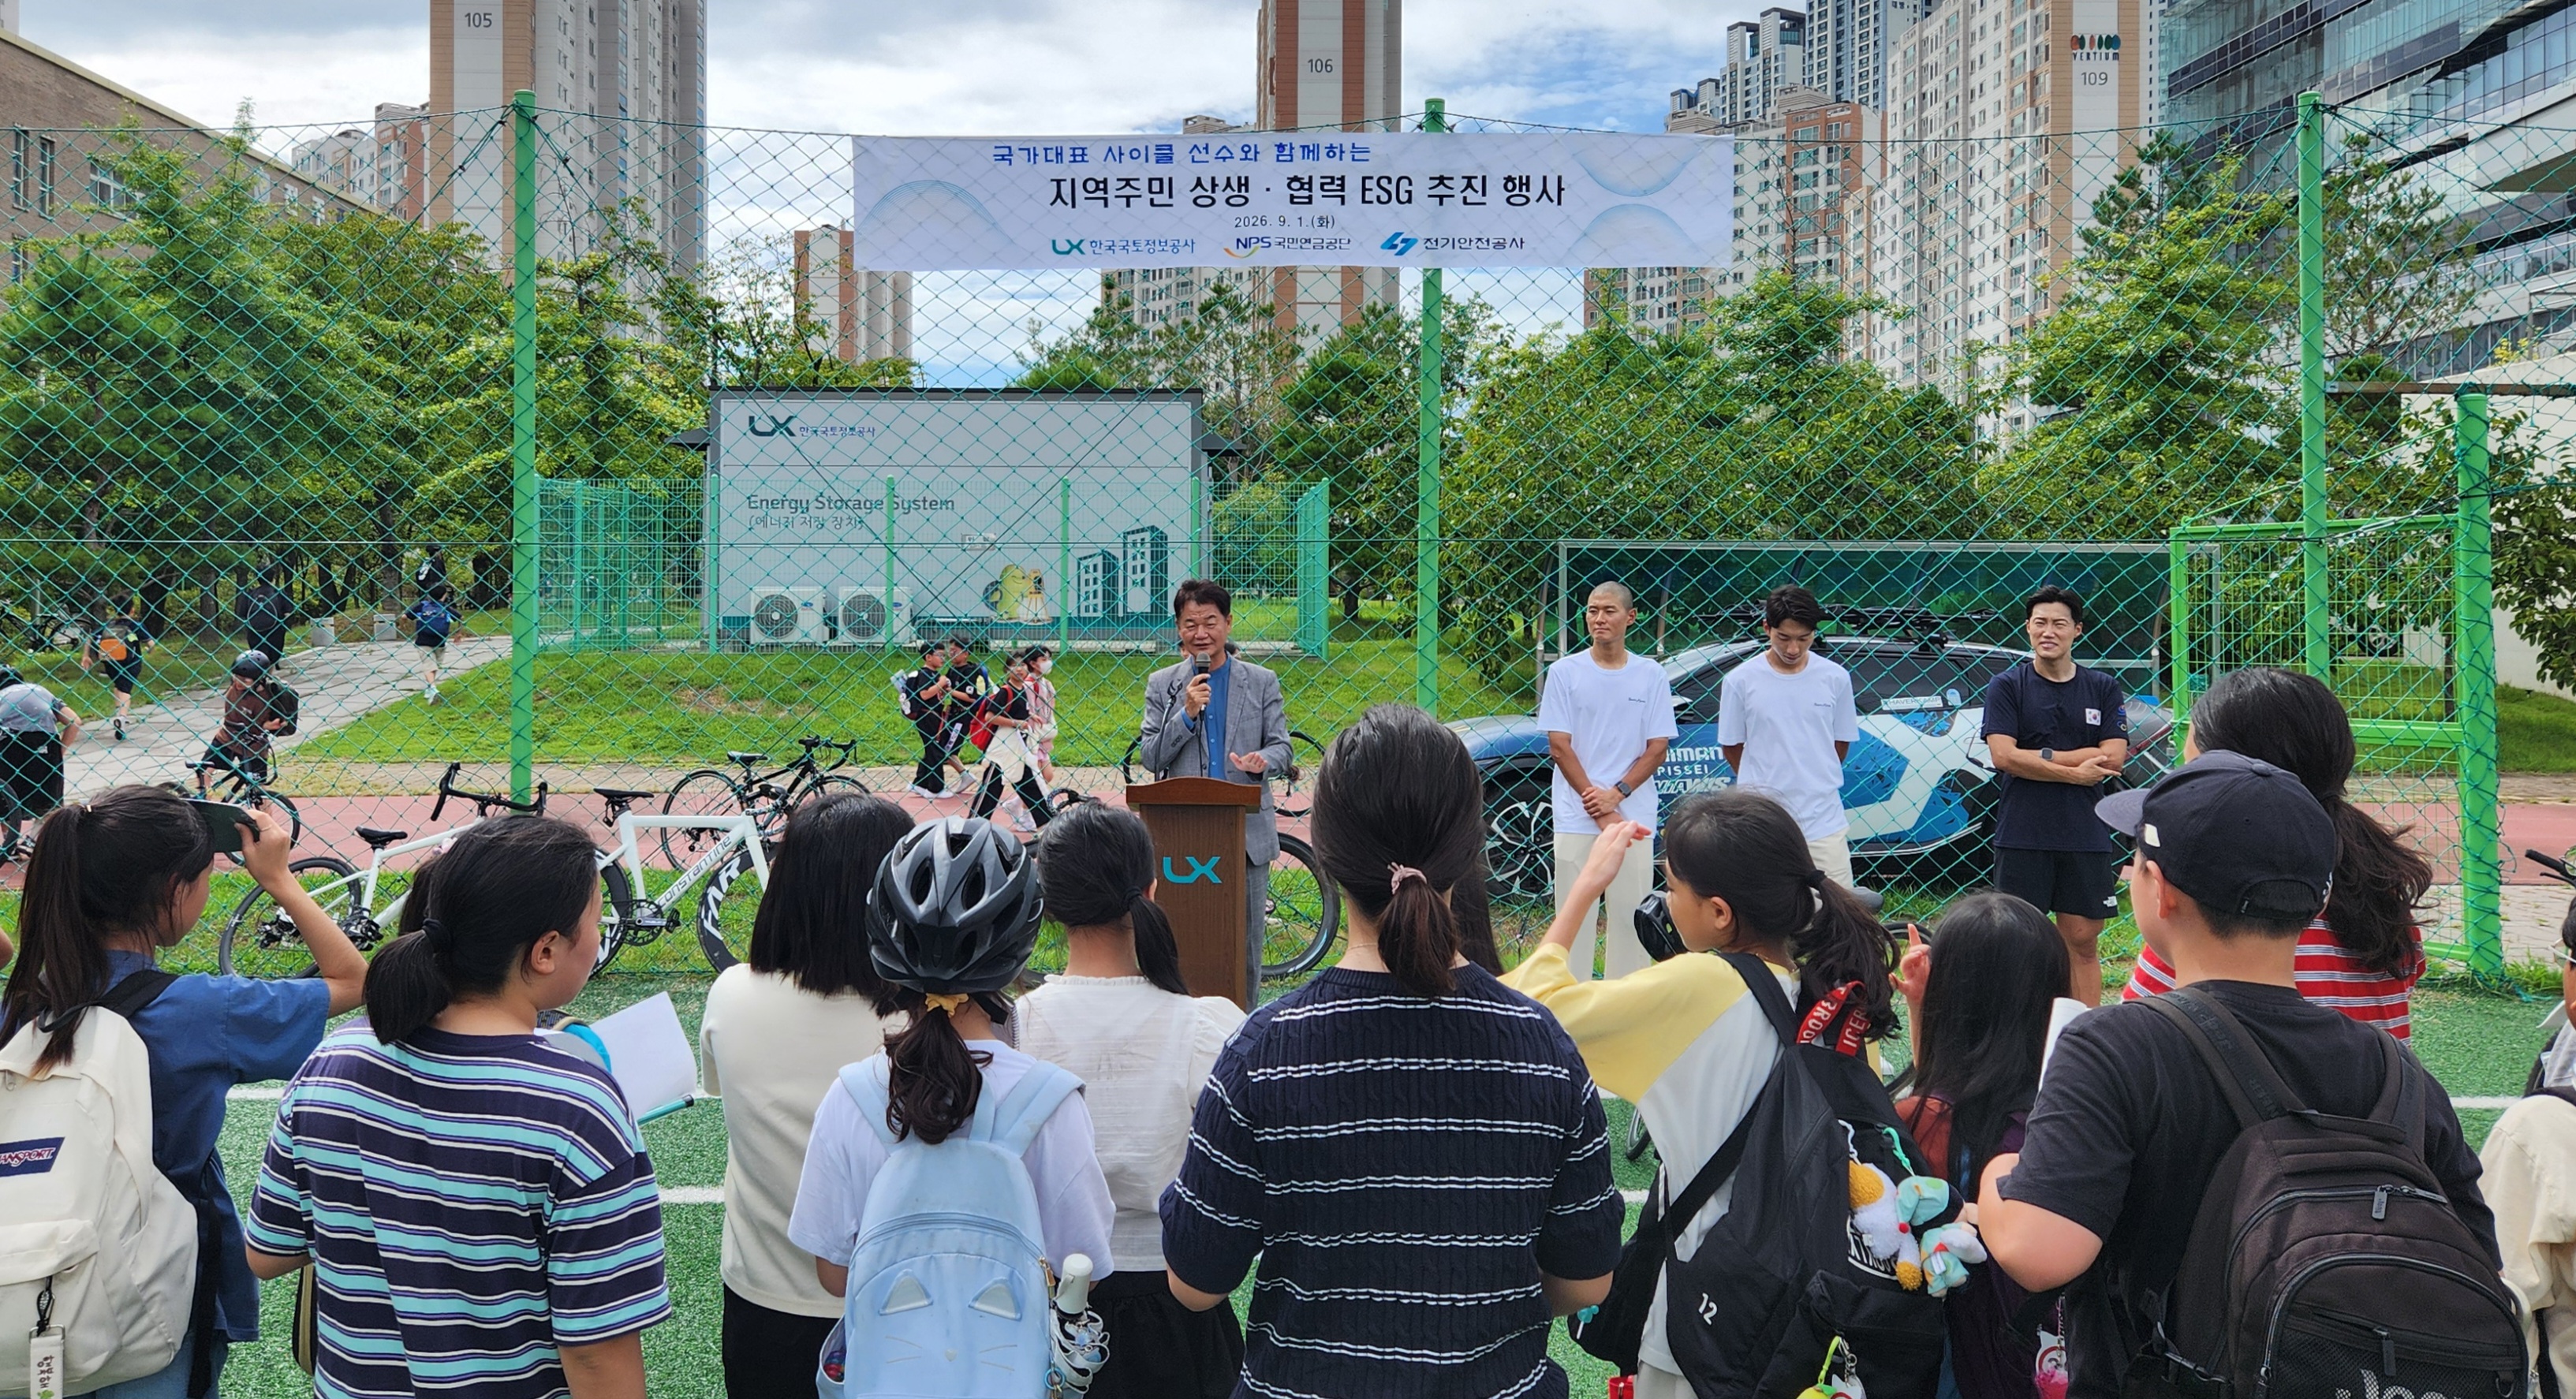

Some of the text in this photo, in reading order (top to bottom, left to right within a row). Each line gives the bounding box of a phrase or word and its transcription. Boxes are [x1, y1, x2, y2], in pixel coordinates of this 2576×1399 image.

[464, 12, 492, 28] 105
[1308, 58, 1333, 73] 106
[2073, 52, 2119, 61] VERTIUM
[2081, 72, 2108, 85] 109
[992, 142, 1371, 166] 국가대표 사이클 선수와 함께하는
[1049, 177, 1174, 209] 지역주민
[1189, 175, 1250, 208] 상생
[1286, 175, 1346, 206] 협력
[1361, 175, 1413, 205] ESG
[1427, 174, 1488, 207] 추진
[1503, 175, 1566, 207] 행사
[1234, 215, 1272, 228] 2026.
[1051, 238, 1196, 256] LX 한국국토정보공사
[1236, 237, 1351, 251] NPS 국민연금공단
[1423, 237, 1525, 251] 전기안전공사
[749, 415, 797, 437] LX
[748, 494, 954, 514] Energy Storage System
[1163, 856, 1223, 883] LX
[0, 1147, 56, 1167] ANSPORT
[1698, 1293, 1718, 1325] 12
